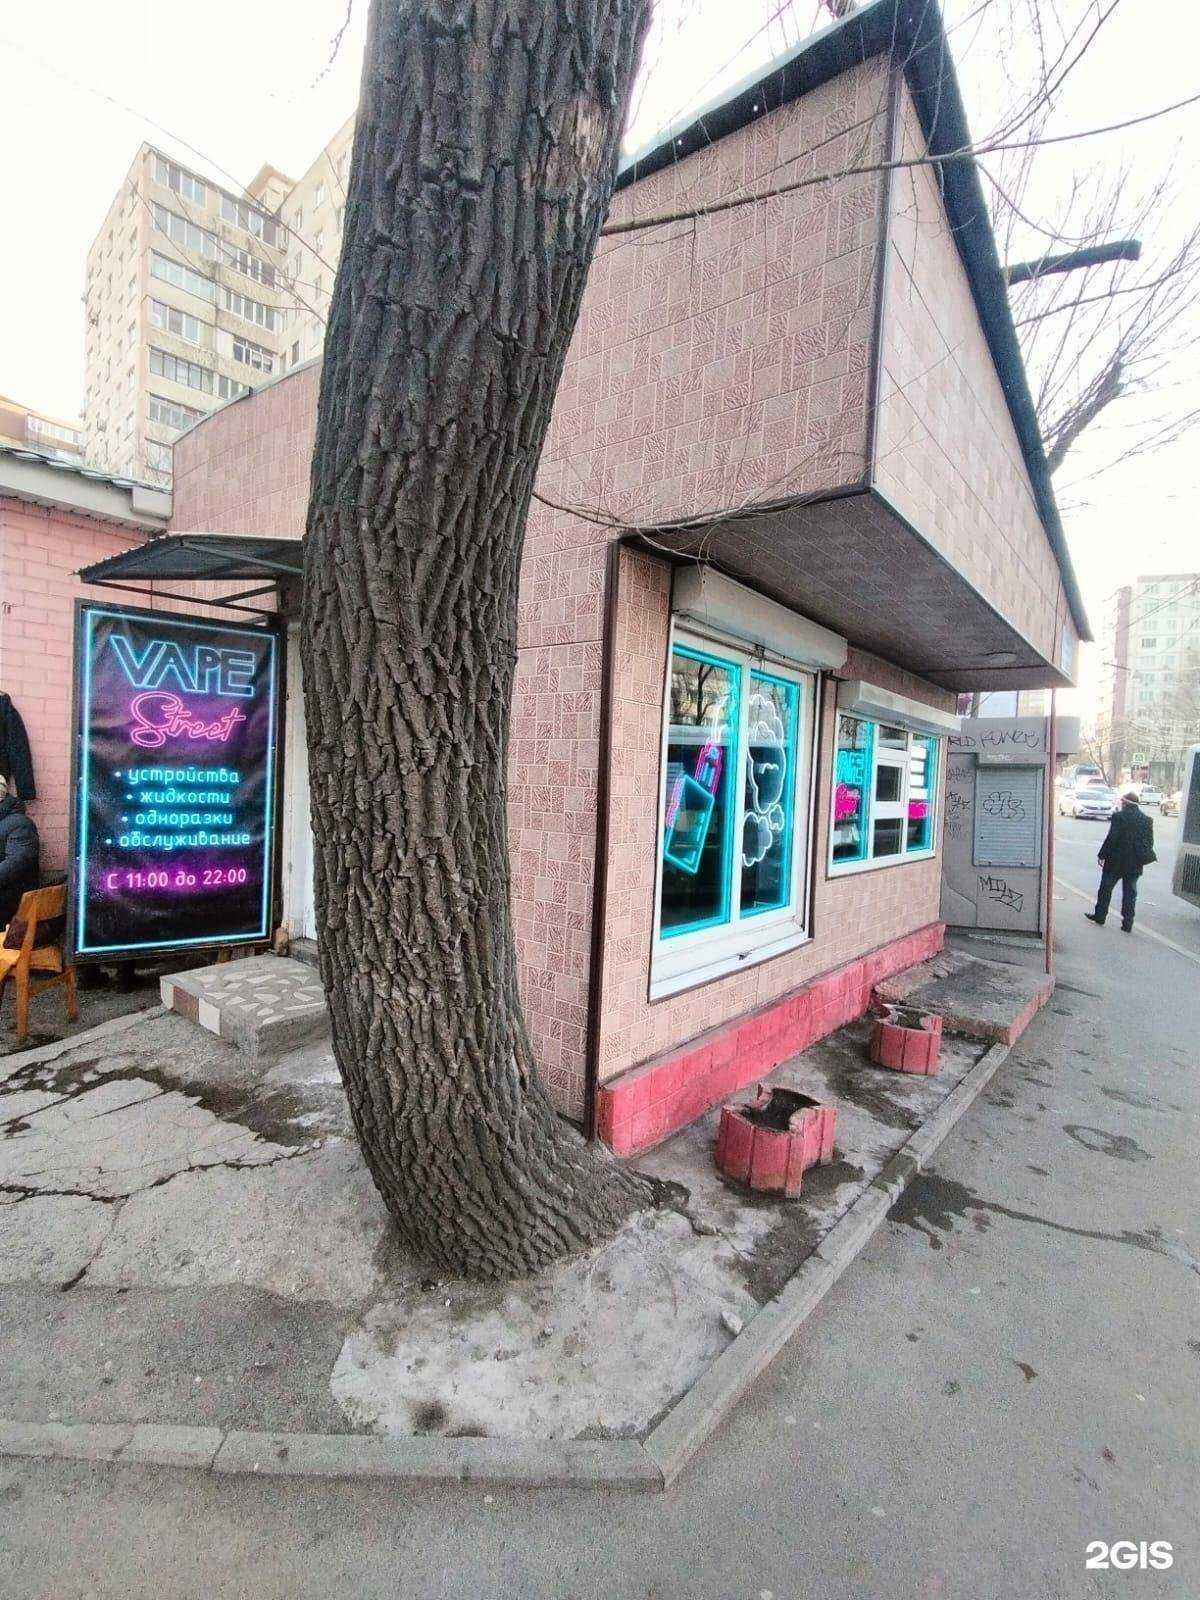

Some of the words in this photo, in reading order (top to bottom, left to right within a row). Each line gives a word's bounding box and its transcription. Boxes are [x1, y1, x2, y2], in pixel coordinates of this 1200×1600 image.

[110, 635, 255, 697] VAPE
[131, 691, 247, 748] Street
[128, 767, 240, 785] устройства
[140, 788, 230, 804] жидкости
[135, 810, 233, 828] одноразки
[119, 831, 251, 851] обслуживание
[126, 871, 169, 889] 11:00
[175, 870, 196, 886] до
[203, 868, 247, 885] 22:00
